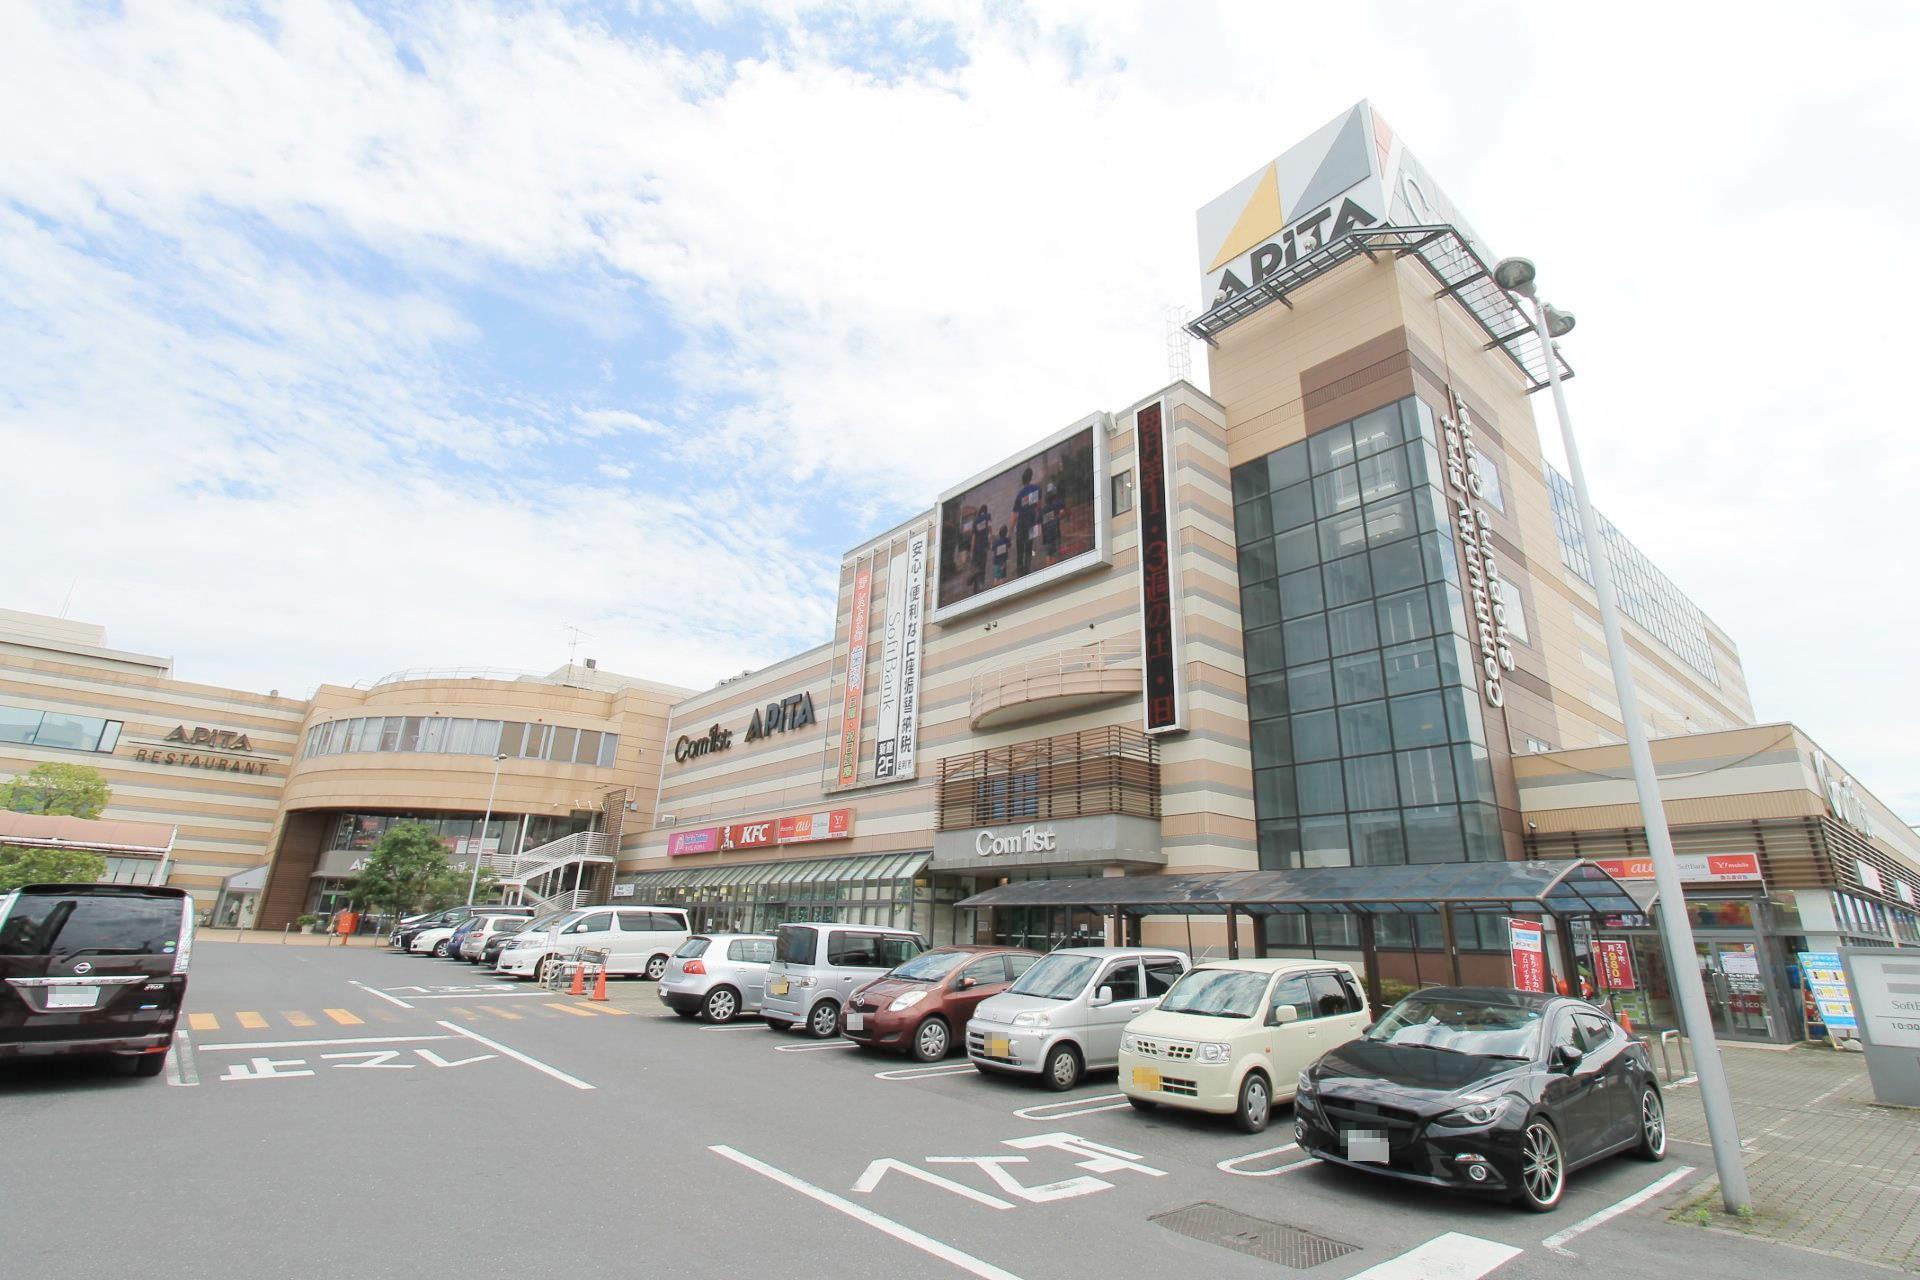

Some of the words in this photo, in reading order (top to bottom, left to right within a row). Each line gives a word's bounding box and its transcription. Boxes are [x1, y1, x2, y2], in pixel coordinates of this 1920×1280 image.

[1440, 414, 1467, 493] First
[1454, 392, 1484, 499] Center
[1457, 497, 1503, 708] Community
[882, 611, 901, 712] SoftBank
[164, 724, 253, 751] APITA
[674, 723, 733, 763] Com1st
[877, 755, 894, 777] 2F
[740, 823, 770, 844] KFC
[796, 820, 810, 832] au
[975, 825, 1056, 857] Com1st
